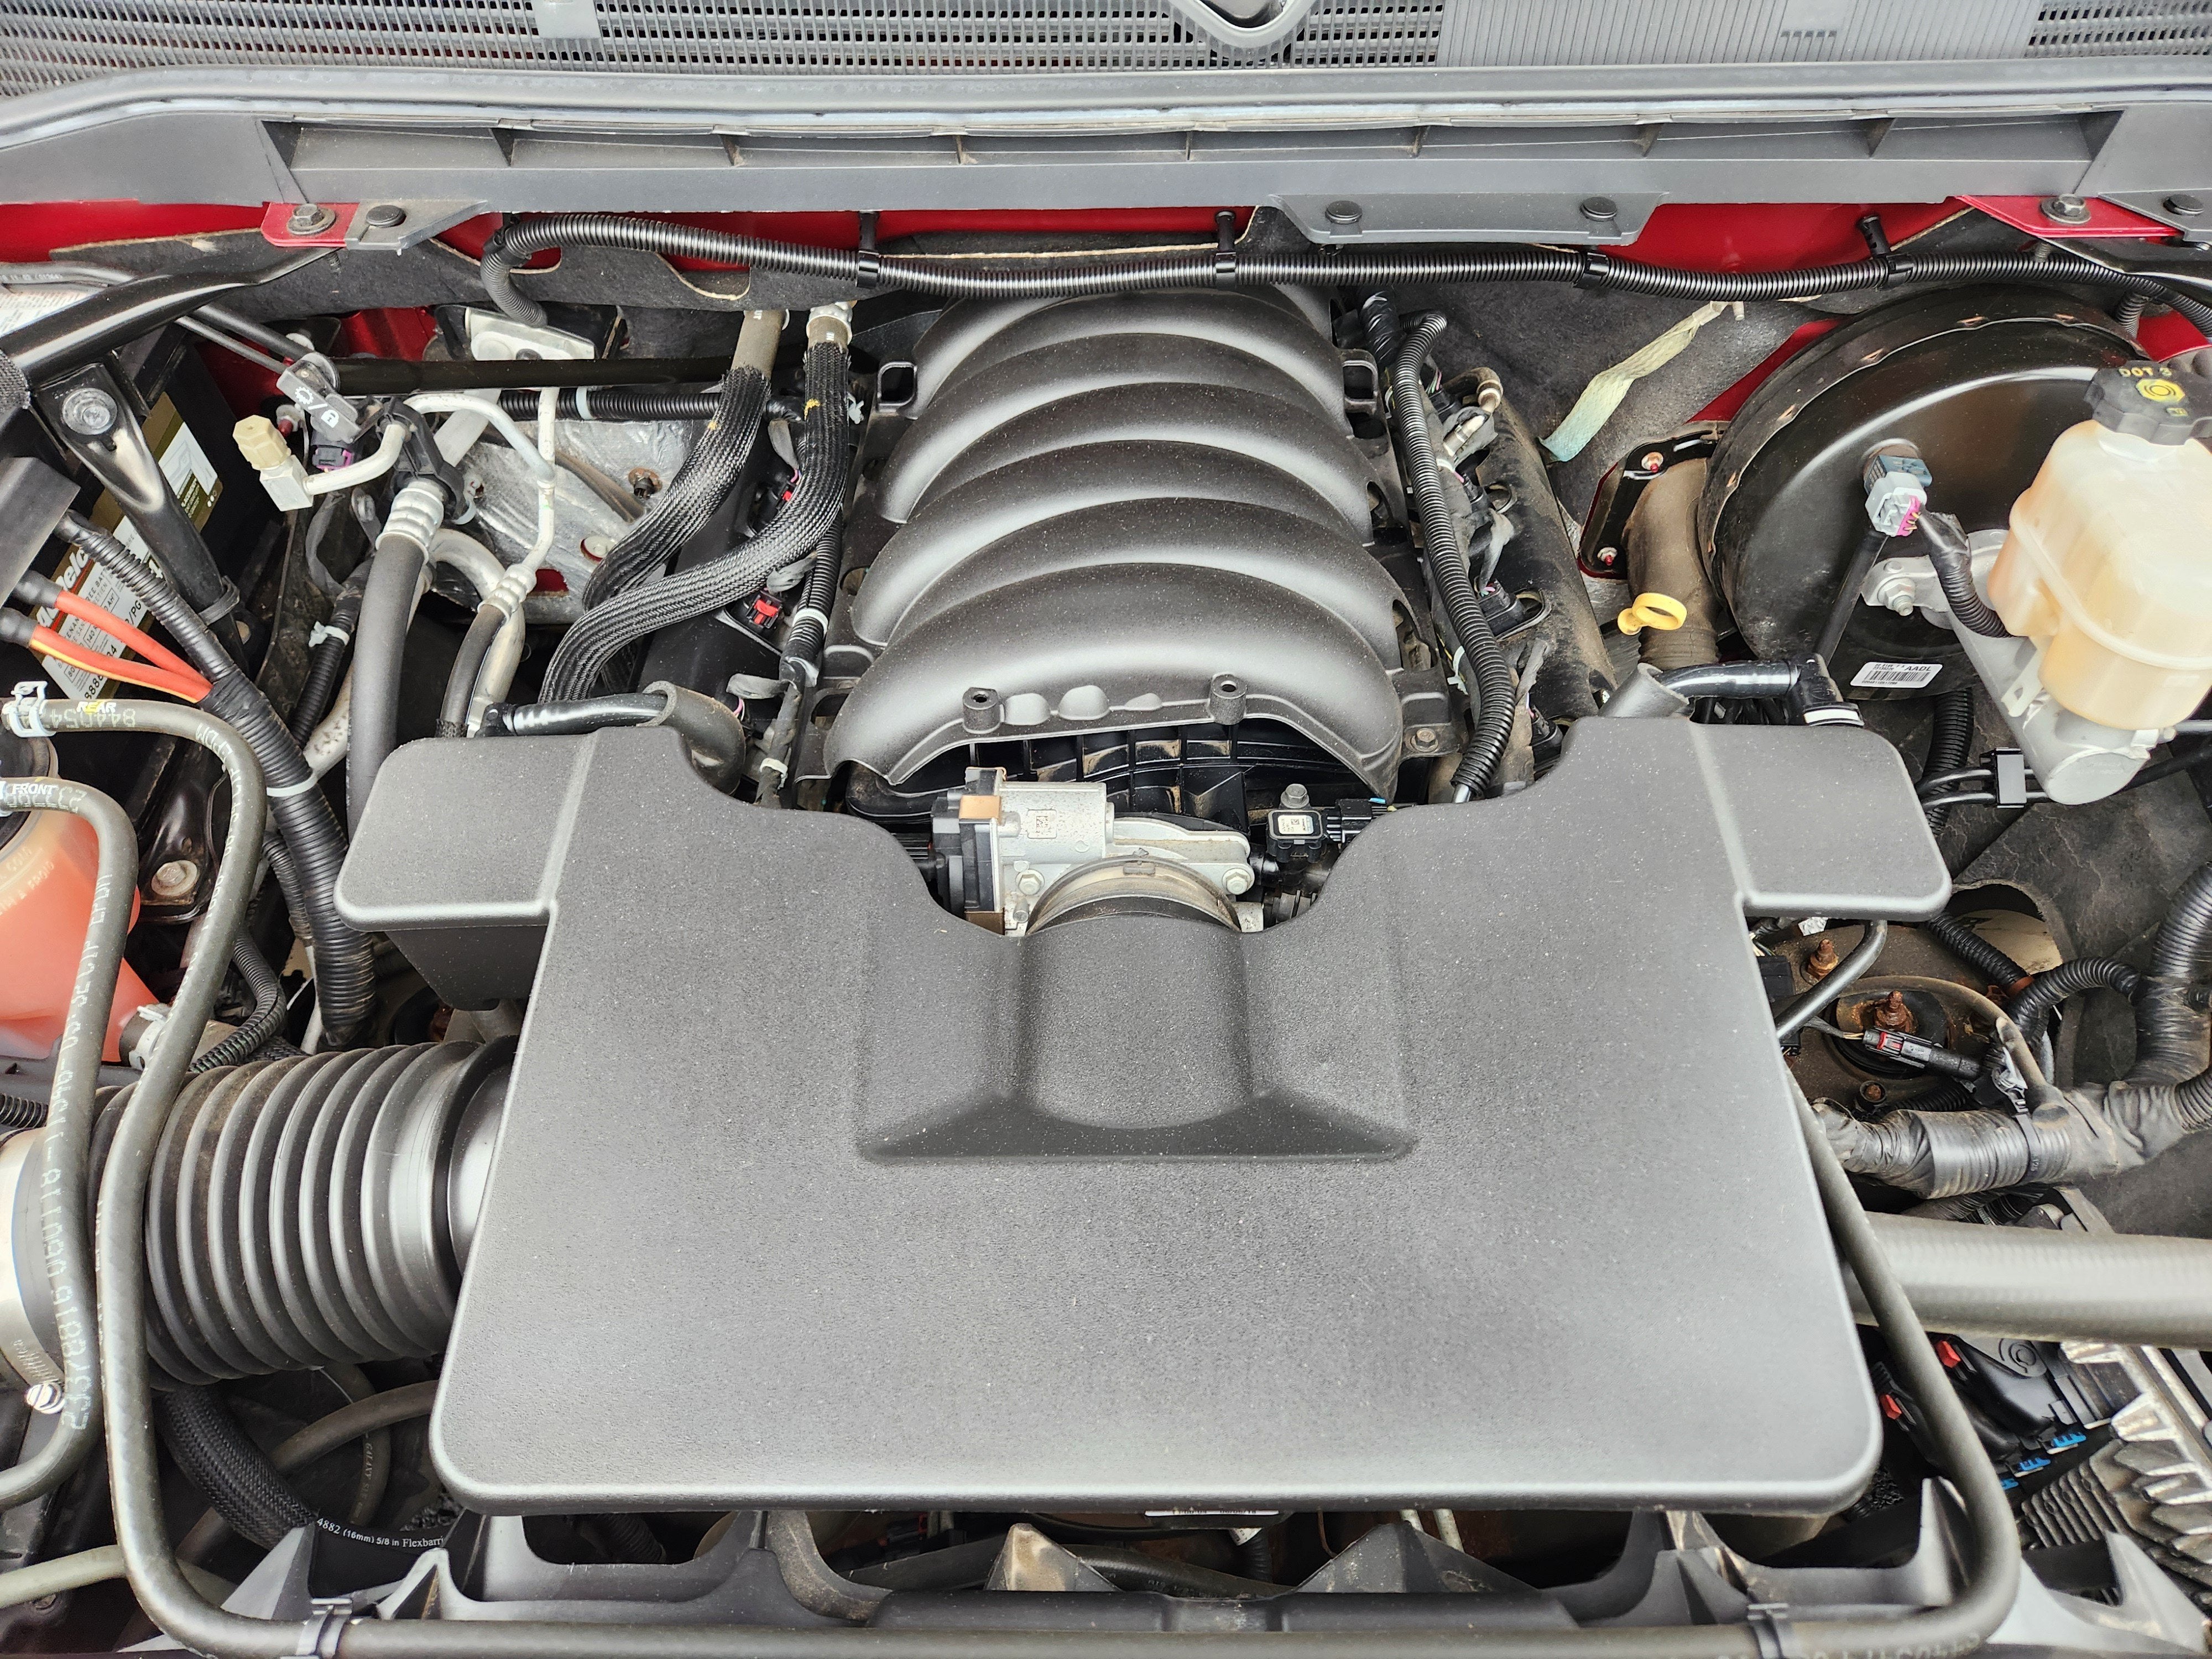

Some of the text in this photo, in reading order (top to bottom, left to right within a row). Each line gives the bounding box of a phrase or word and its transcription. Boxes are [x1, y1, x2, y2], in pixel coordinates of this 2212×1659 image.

[753, 309, 763, 320] UT
[826, 332, 835, 341] IN
[2118, 366, 2172, 378] DOT 3
[86, 630, 95, 643] 140
[76, 701, 117, 713] REAR
[12, 783, 59, 795] FRONT
[88, 874, 112, 927] EPDM
[316, 1517, 341, 1535] 4882
[342, 1528, 375, 1543] (16mm)
[376, 1537, 390, 1546] 5/8
[403, 1536, 444, 1547] Flexbarri
